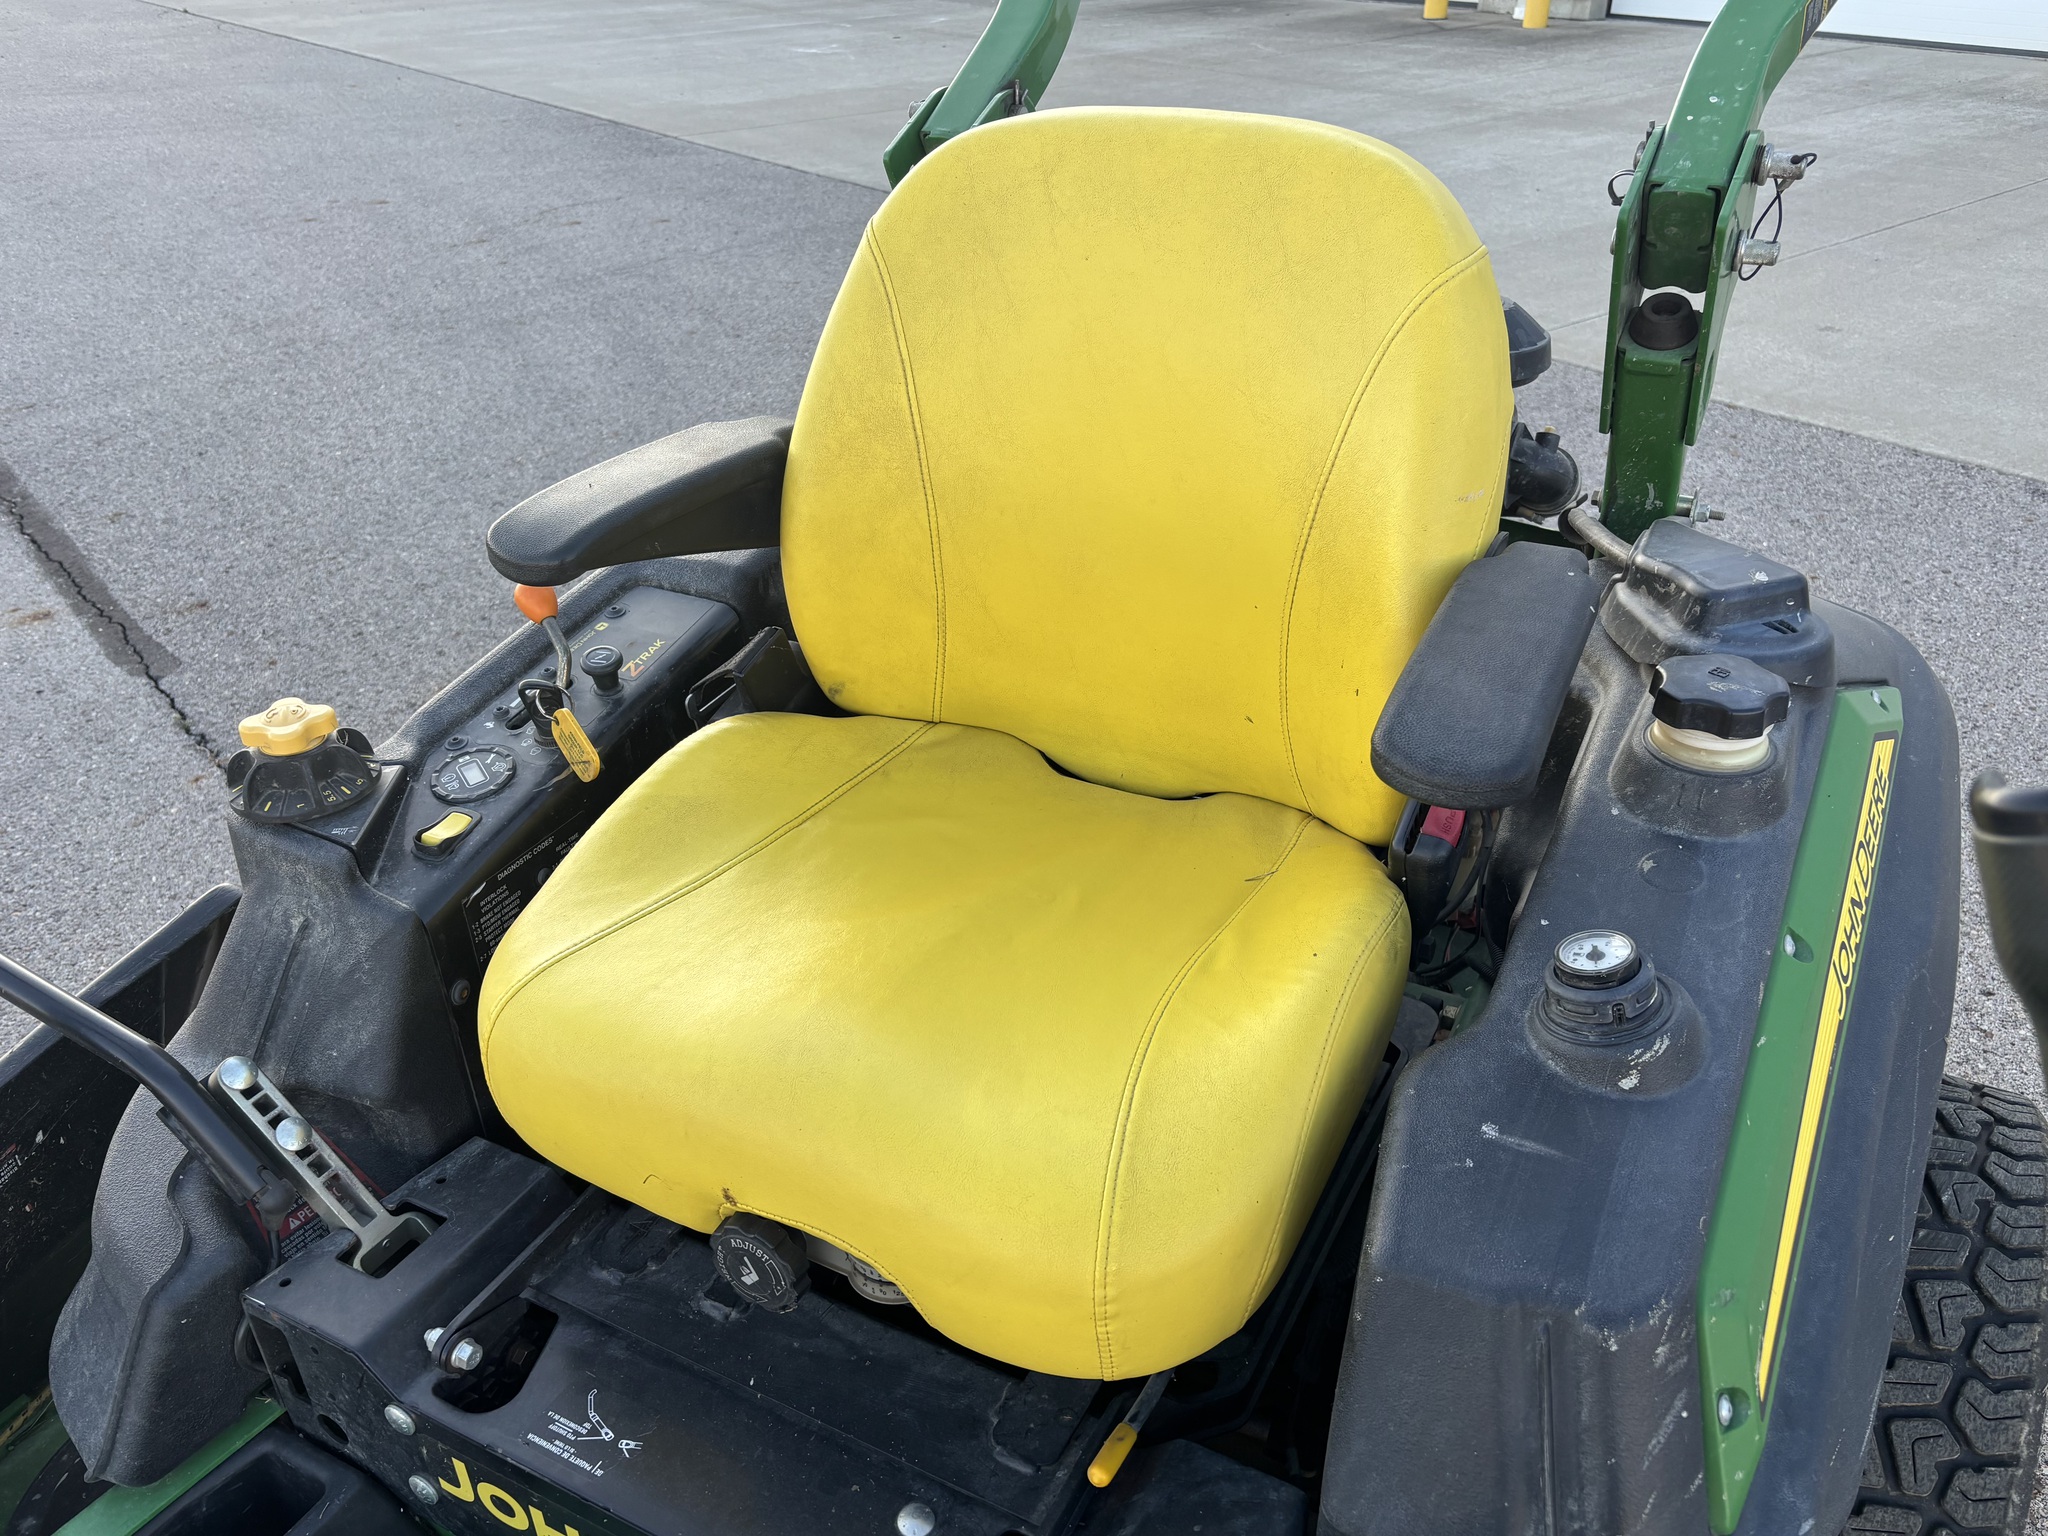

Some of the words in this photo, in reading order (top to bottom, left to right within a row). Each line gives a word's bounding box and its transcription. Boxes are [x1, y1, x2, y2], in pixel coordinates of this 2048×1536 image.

[497, 852, 533, 881] DIAGNOSTIC
[480, 884, 508, 907] INTERLOCK
[1832, 877, 1867, 1020] JOHN
[1855, 753, 1889, 898] DEERE
[481, 890, 510, 914] VIOLATIONS
[502, 890, 521, 907] ENGAGED
[483, 921, 501, 937] STARTER
[485, 927, 503, 943] PROTECT
[281, 1235, 305, 1254] causadas
[730, 1238, 769, 1262] ADJUST
[527, 1432, 561, 1456] CONVENIENCIA
[568, 1454, 593, 1471] PAQUETE
